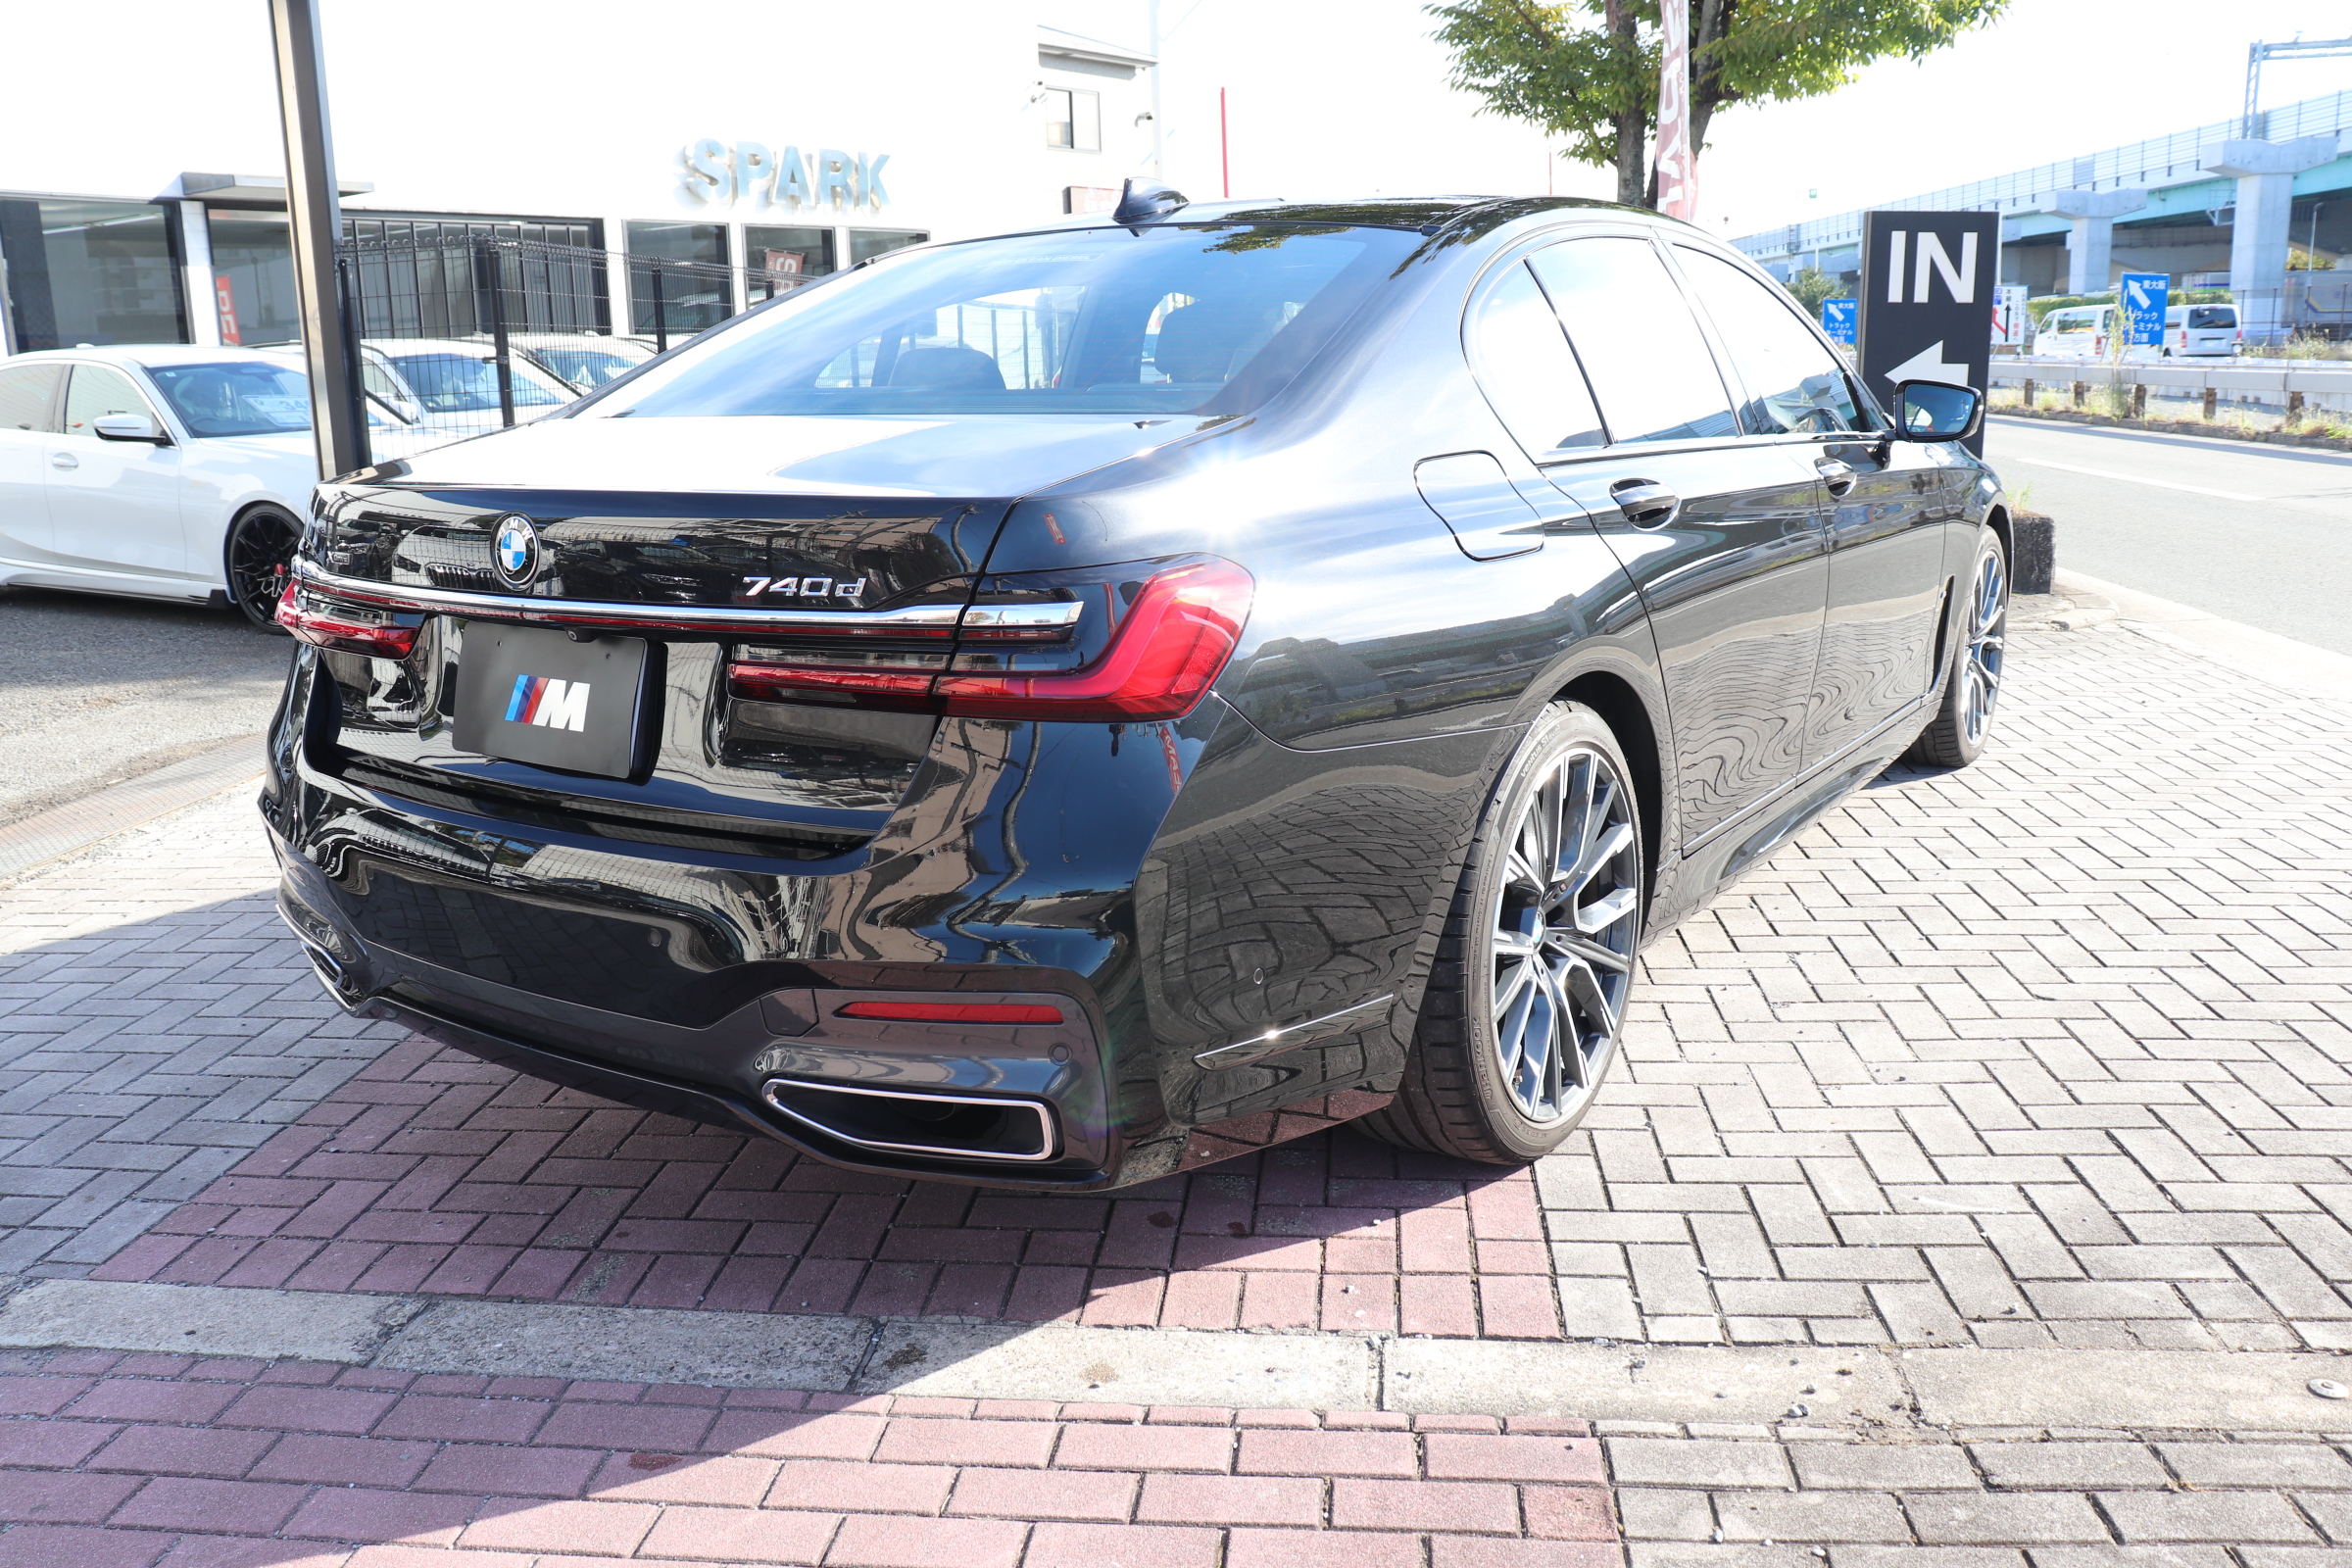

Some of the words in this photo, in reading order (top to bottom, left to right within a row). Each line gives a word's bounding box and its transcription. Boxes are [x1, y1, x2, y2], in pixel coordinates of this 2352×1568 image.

[686, 137, 891, 208] SPARK
[1887, 230, 1978, 303] IN
[2142, 280, 2166, 289] 東大阪
[2129, 311, 2158, 320] ラック
[498, 518, 533, 542] BMW
[742, 576, 867, 597] 740d
[531, 678, 591, 733] M
